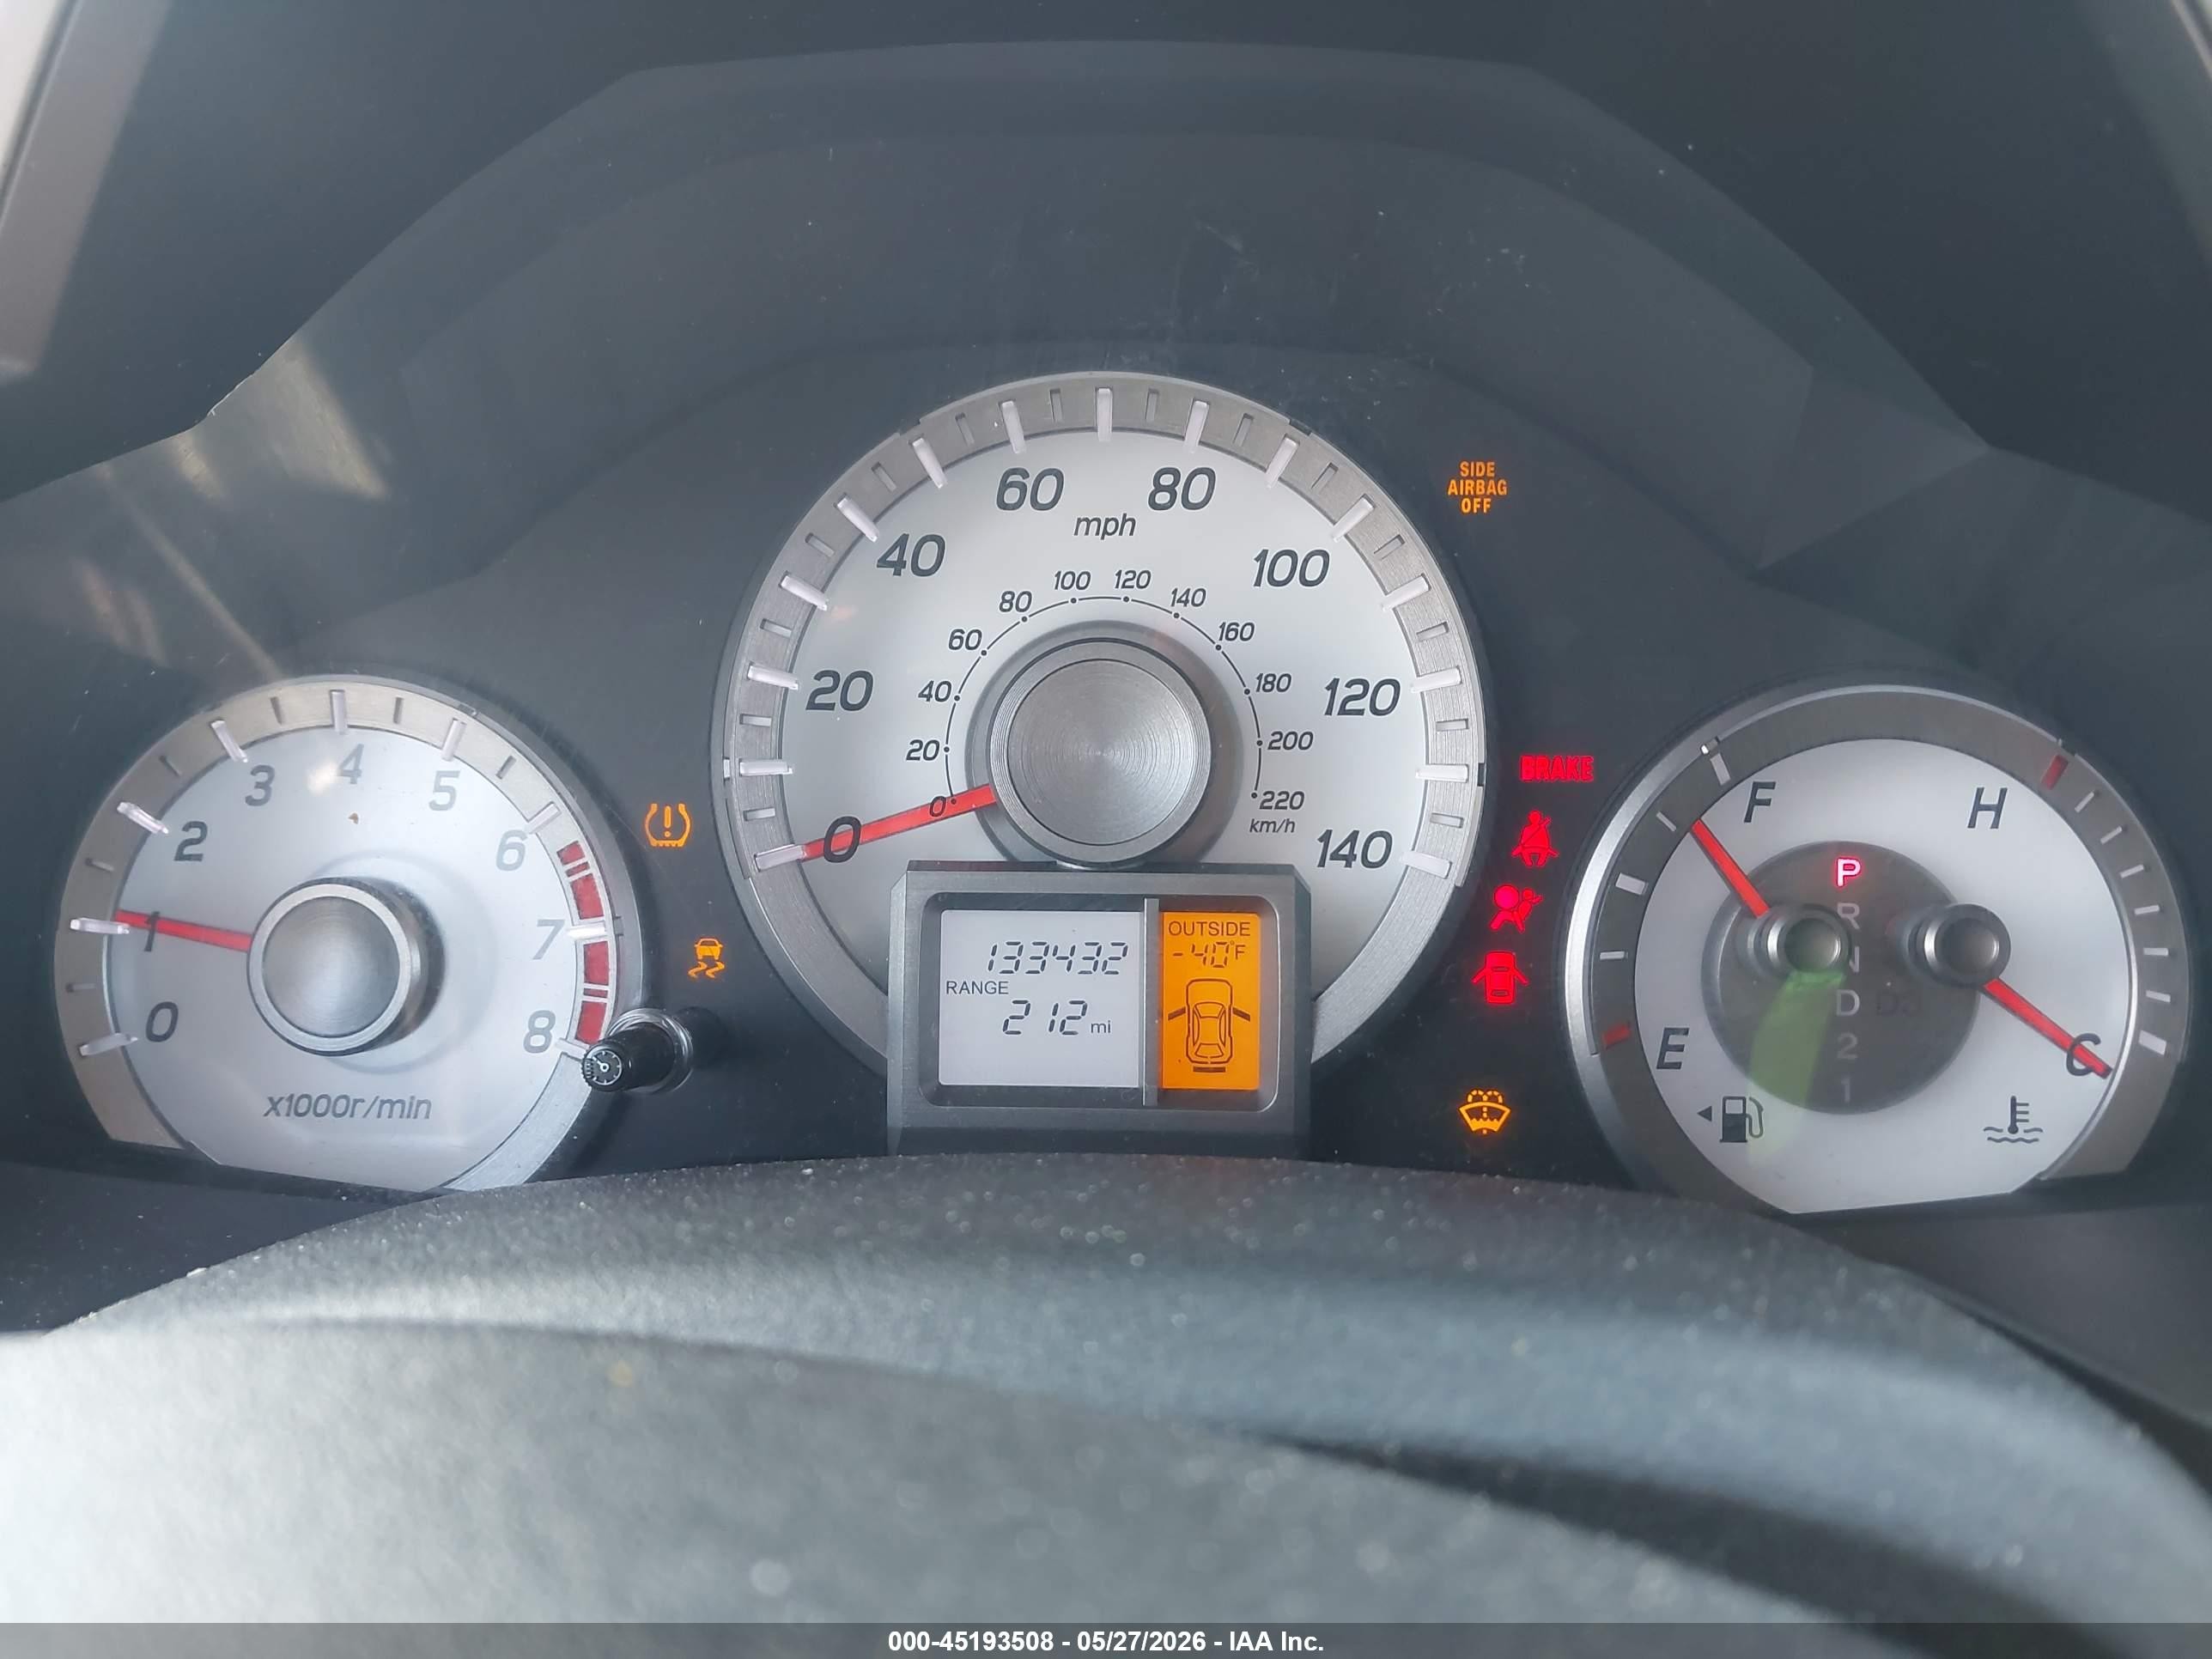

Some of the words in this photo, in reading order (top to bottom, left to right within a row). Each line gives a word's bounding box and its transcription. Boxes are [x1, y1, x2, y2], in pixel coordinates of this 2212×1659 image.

[1459, 460, 1495, 477] SIDE
[996, 467, 1064, 511] 60
[1149, 467, 1216, 511] 80
[1447, 478, 1508, 496] AIRBAG
[1461, 497, 1492, 514] OFF
[1074, 514, 1136, 540] mph
[877, 533, 945, 577] 40
[1254, 549, 1330, 588] 100
[1054, 570, 1091, 590] 100
[1115, 569, 1151, 589] 120
[999, 591, 1032, 612] 80
[1170, 587, 1206, 607] 140
[948, 629, 982, 650] 60
[1218, 622, 1255, 641] 160
[805, 670, 873, 711] 20
[918, 680, 952, 702] 40
[1255, 672, 1291, 693] 180
[1324, 678, 1401, 716] 120
[906, 738, 939, 761] 20
[1267, 731, 1314, 750] 200
[336, 744, 364, 785] 4
[1520, 755, 1595, 782] BRAKE
[245, 765, 276, 806] 3
[429, 770, 460, 811] 5
[928, 795, 946, 817] 0
[1259, 791, 1305, 810] 220
[1744, 781, 1776, 823] F
[1967, 787, 2008, 830] H
[823, 816, 861, 863] 0
[1249, 818, 1296, 835] km/h
[173, 820, 209, 862] 2
[495, 830, 526, 871] 6
[1316, 830, 1392, 869] 140
[1836, 857, 1862, 887] P
[1168, 921, 1251, 937] OUTSIDE
[1837, 902, 1860, 930] R
[143, 911, 161, 953] 1
[534, 919, 565, 960] 7
[988, 940, 1129, 975] 133432
[946, 981, 1009, 996] RANGE
[1836, 989, 1860, 1017] D
[146, 1001, 179, 1042] 0
[1002, 999, 1088, 1036] 212
[1090, 1019, 1112, 1035] mi
[522, 1010, 556, 1054] 8
[1837, 1032, 1858, 1060] 2
[1656, 1026, 1689, 1071] E
[2065, 1033, 2101, 1078] C
[1841, 1079, 1850, 1103] 1
[263, 1093, 433, 1121] x1000r/min
